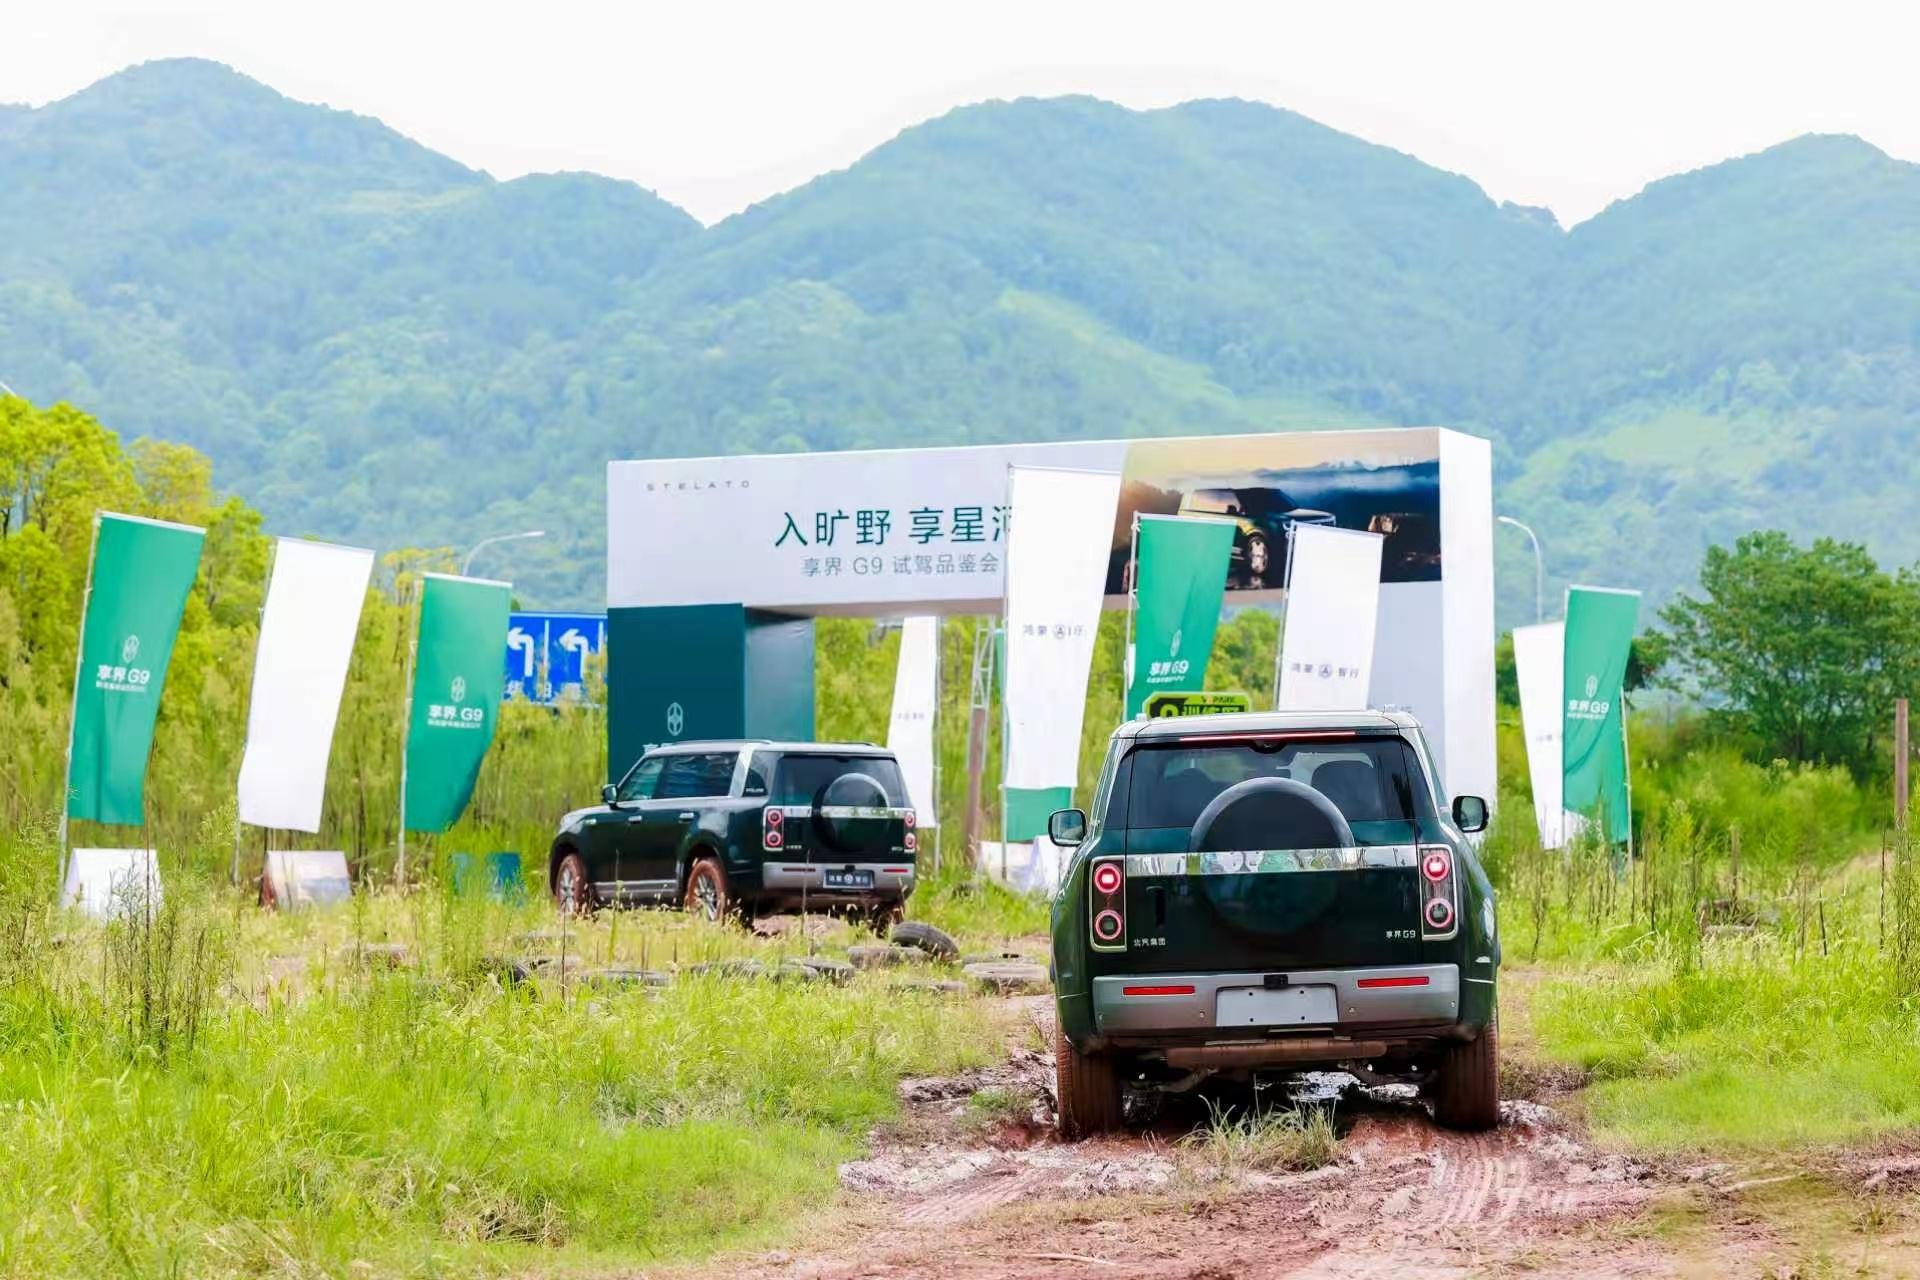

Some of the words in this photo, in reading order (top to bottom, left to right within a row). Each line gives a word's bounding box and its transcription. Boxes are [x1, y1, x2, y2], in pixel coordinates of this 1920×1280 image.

[646, 479, 751, 491] STELATO
[774, 508, 892, 547] 入旷野
[801, 556, 843, 577] 享界
[852, 556, 884, 576] G9
[893, 552, 1000, 576] 试驾品鉴会
[127, 668, 151, 685] G9
[460, 707, 484, 722] G9
